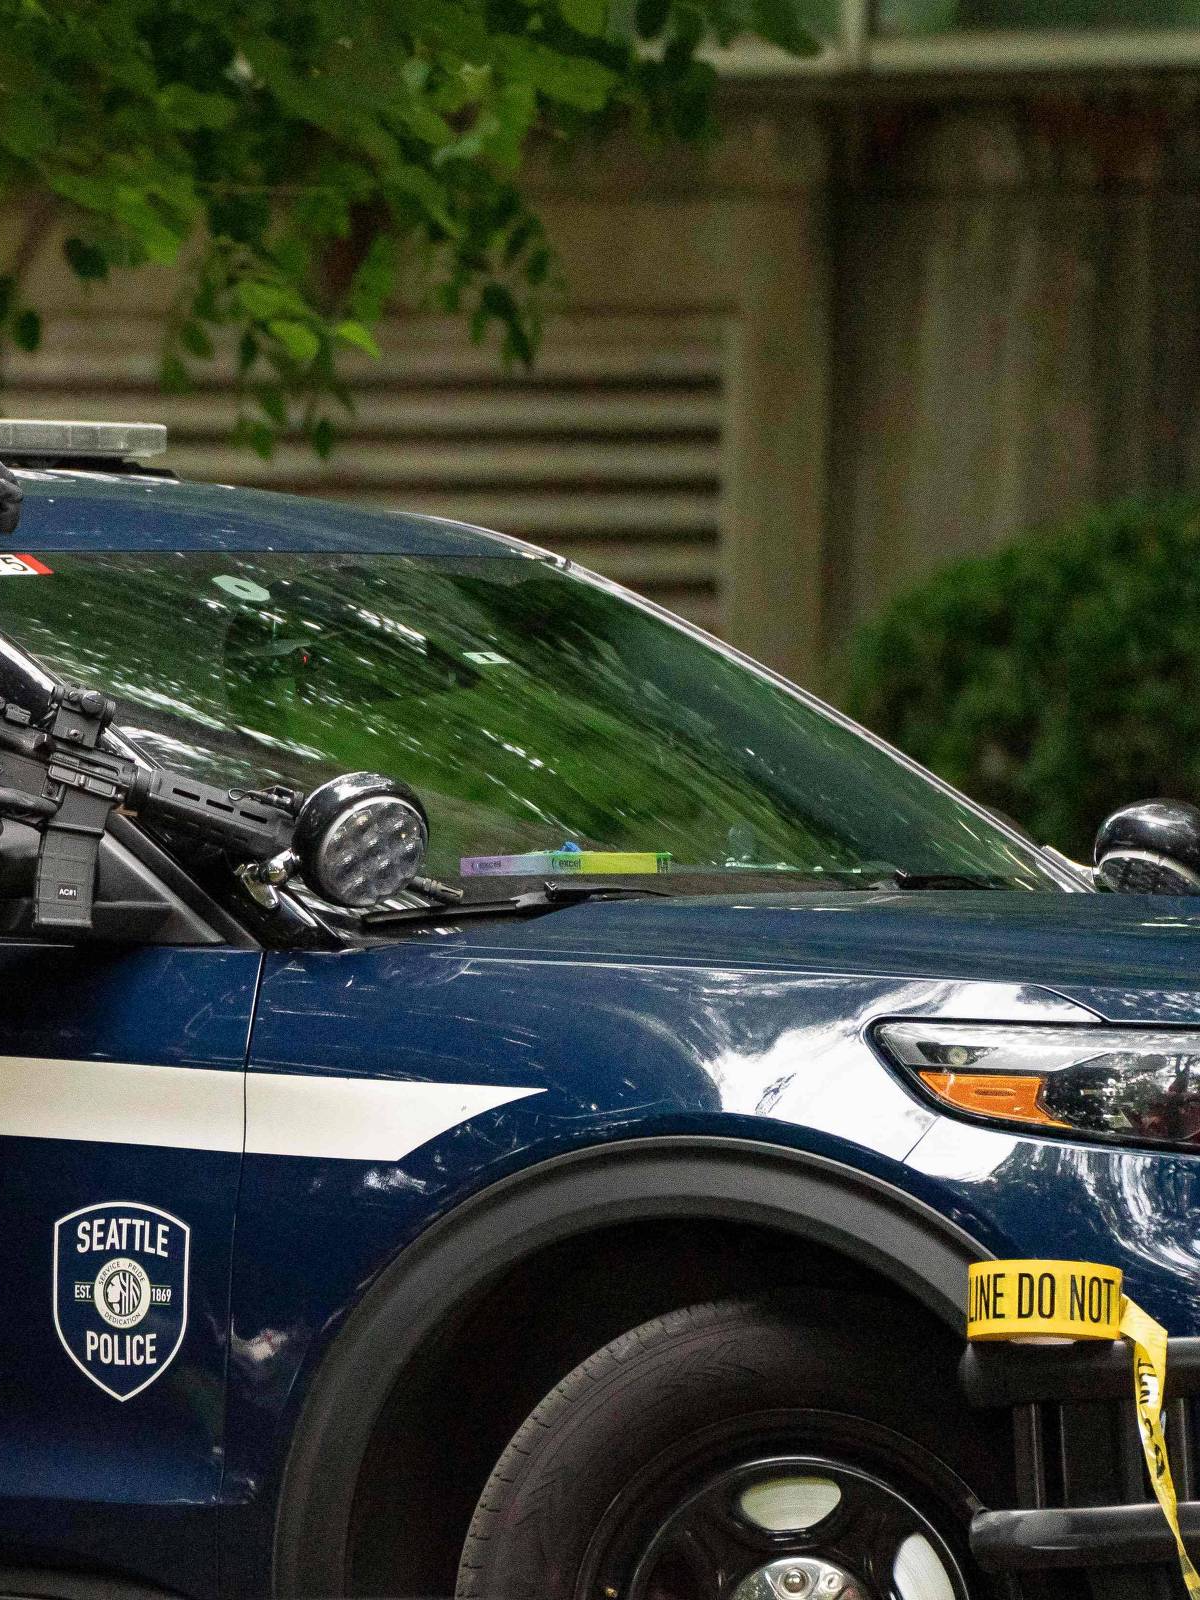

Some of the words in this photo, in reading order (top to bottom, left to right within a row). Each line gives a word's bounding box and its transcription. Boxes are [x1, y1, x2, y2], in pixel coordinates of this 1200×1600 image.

[76, 1218, 170, 1258] SEATTLE
[99, 1261, 121, 1285] SERVICE
[128, 1262, 145, 1282] PRIDE
[74, 1284, 92, 1299] EST.
[151, 1288, 171, 1302] 1869
[968, 1273, 1005, 1323] LINE
[1017, 1272, 1056, 1319] DO
[1069, 1274, 1115, 1325] NOT
[104, 1311, 141, 1325] DEDICATION
[86, 1330, 157, 1366] POLICE
